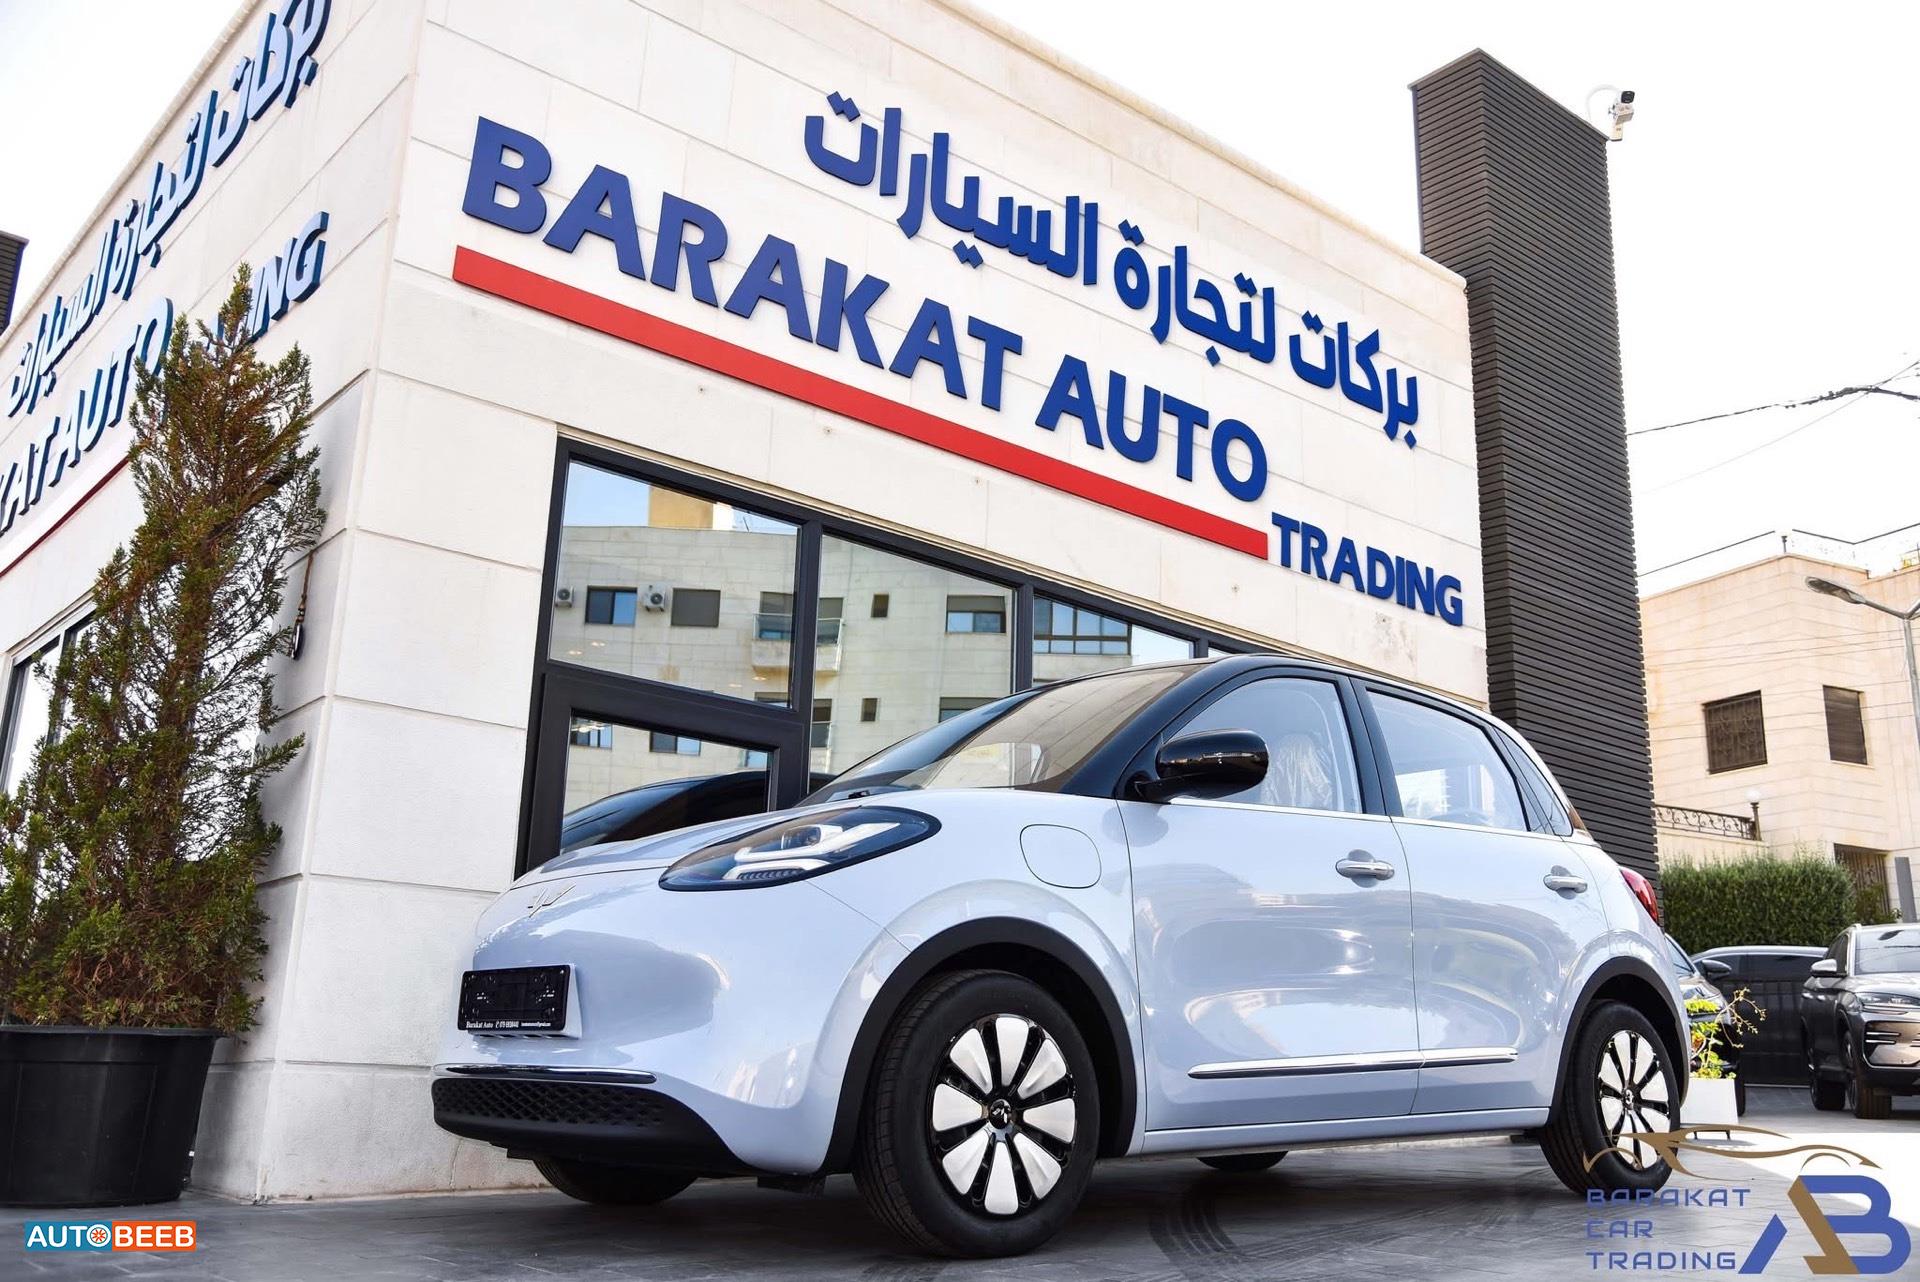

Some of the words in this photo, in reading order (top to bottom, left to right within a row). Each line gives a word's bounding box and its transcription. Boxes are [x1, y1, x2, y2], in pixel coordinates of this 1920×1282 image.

[109, 89, 218, 301] لتجارة
[804, 92, 1099, 286] السيارات
[8, 218, 119, 418] السيارات
[462, 116, 1023, 411] BARAKAT
[1035, 354, 1268, 502] AUTO
[1113, 222, 1276, 366] لتجارة
[1288, 312, 1419, 448] بركات
[1271, 511, 1463, 627] TRADING
